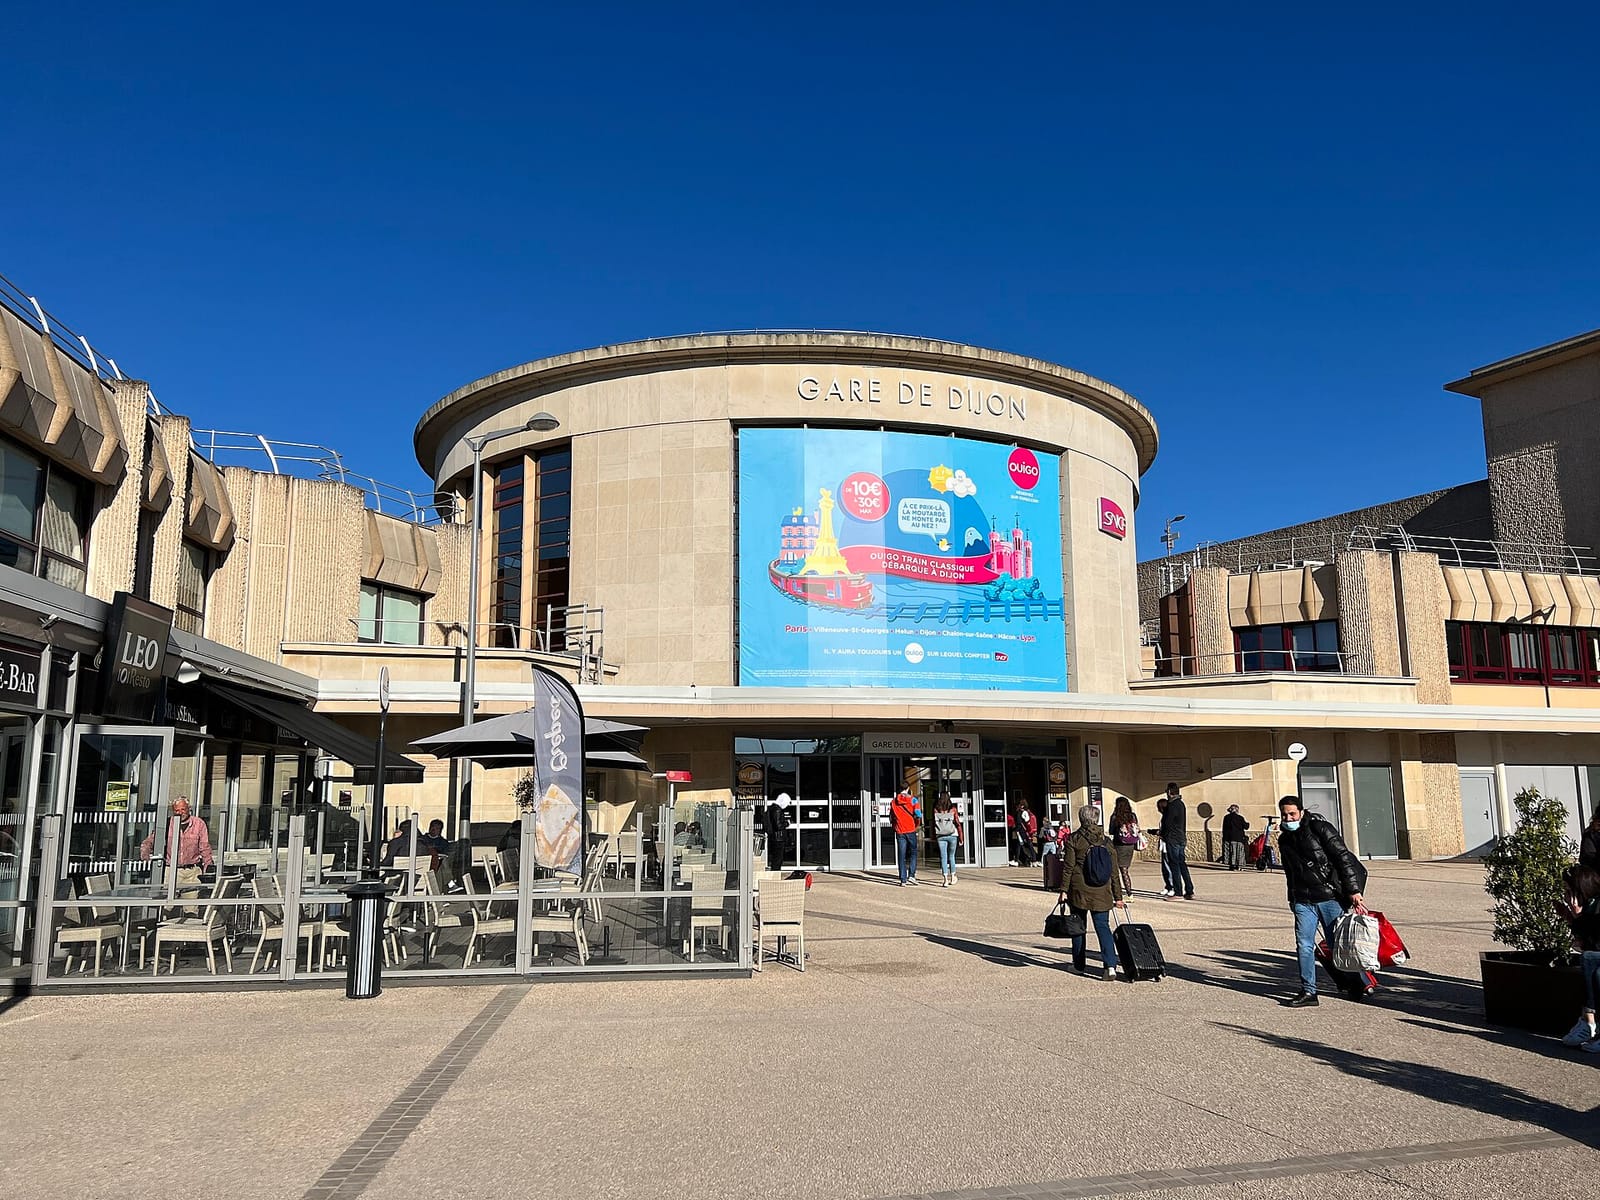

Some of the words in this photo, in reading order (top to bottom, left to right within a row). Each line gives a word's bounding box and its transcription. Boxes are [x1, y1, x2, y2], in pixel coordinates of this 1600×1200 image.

[797, 377, 881, 403] GARE
[898, 381, 932, 407] DE
[948, 385, 1027, 421] DIJON
[851, 481, 882, 496] 10€
[858, 497, 881, 508] 30€
[870, 552, 899, 561] OUIGO
[902, 555, 928, 566] TRAIN
[929, 559, 975, 573] CLASSIQUE
[930, 567, 938, 577] À
[939, 570, 965, 580] DIJON
[785, 625, 808, 634] Paris
[920, 629, 937, 637] Dijon
[1021, 634, 1036, 643] Lyon
[120, 631, 159, 671] LEO
